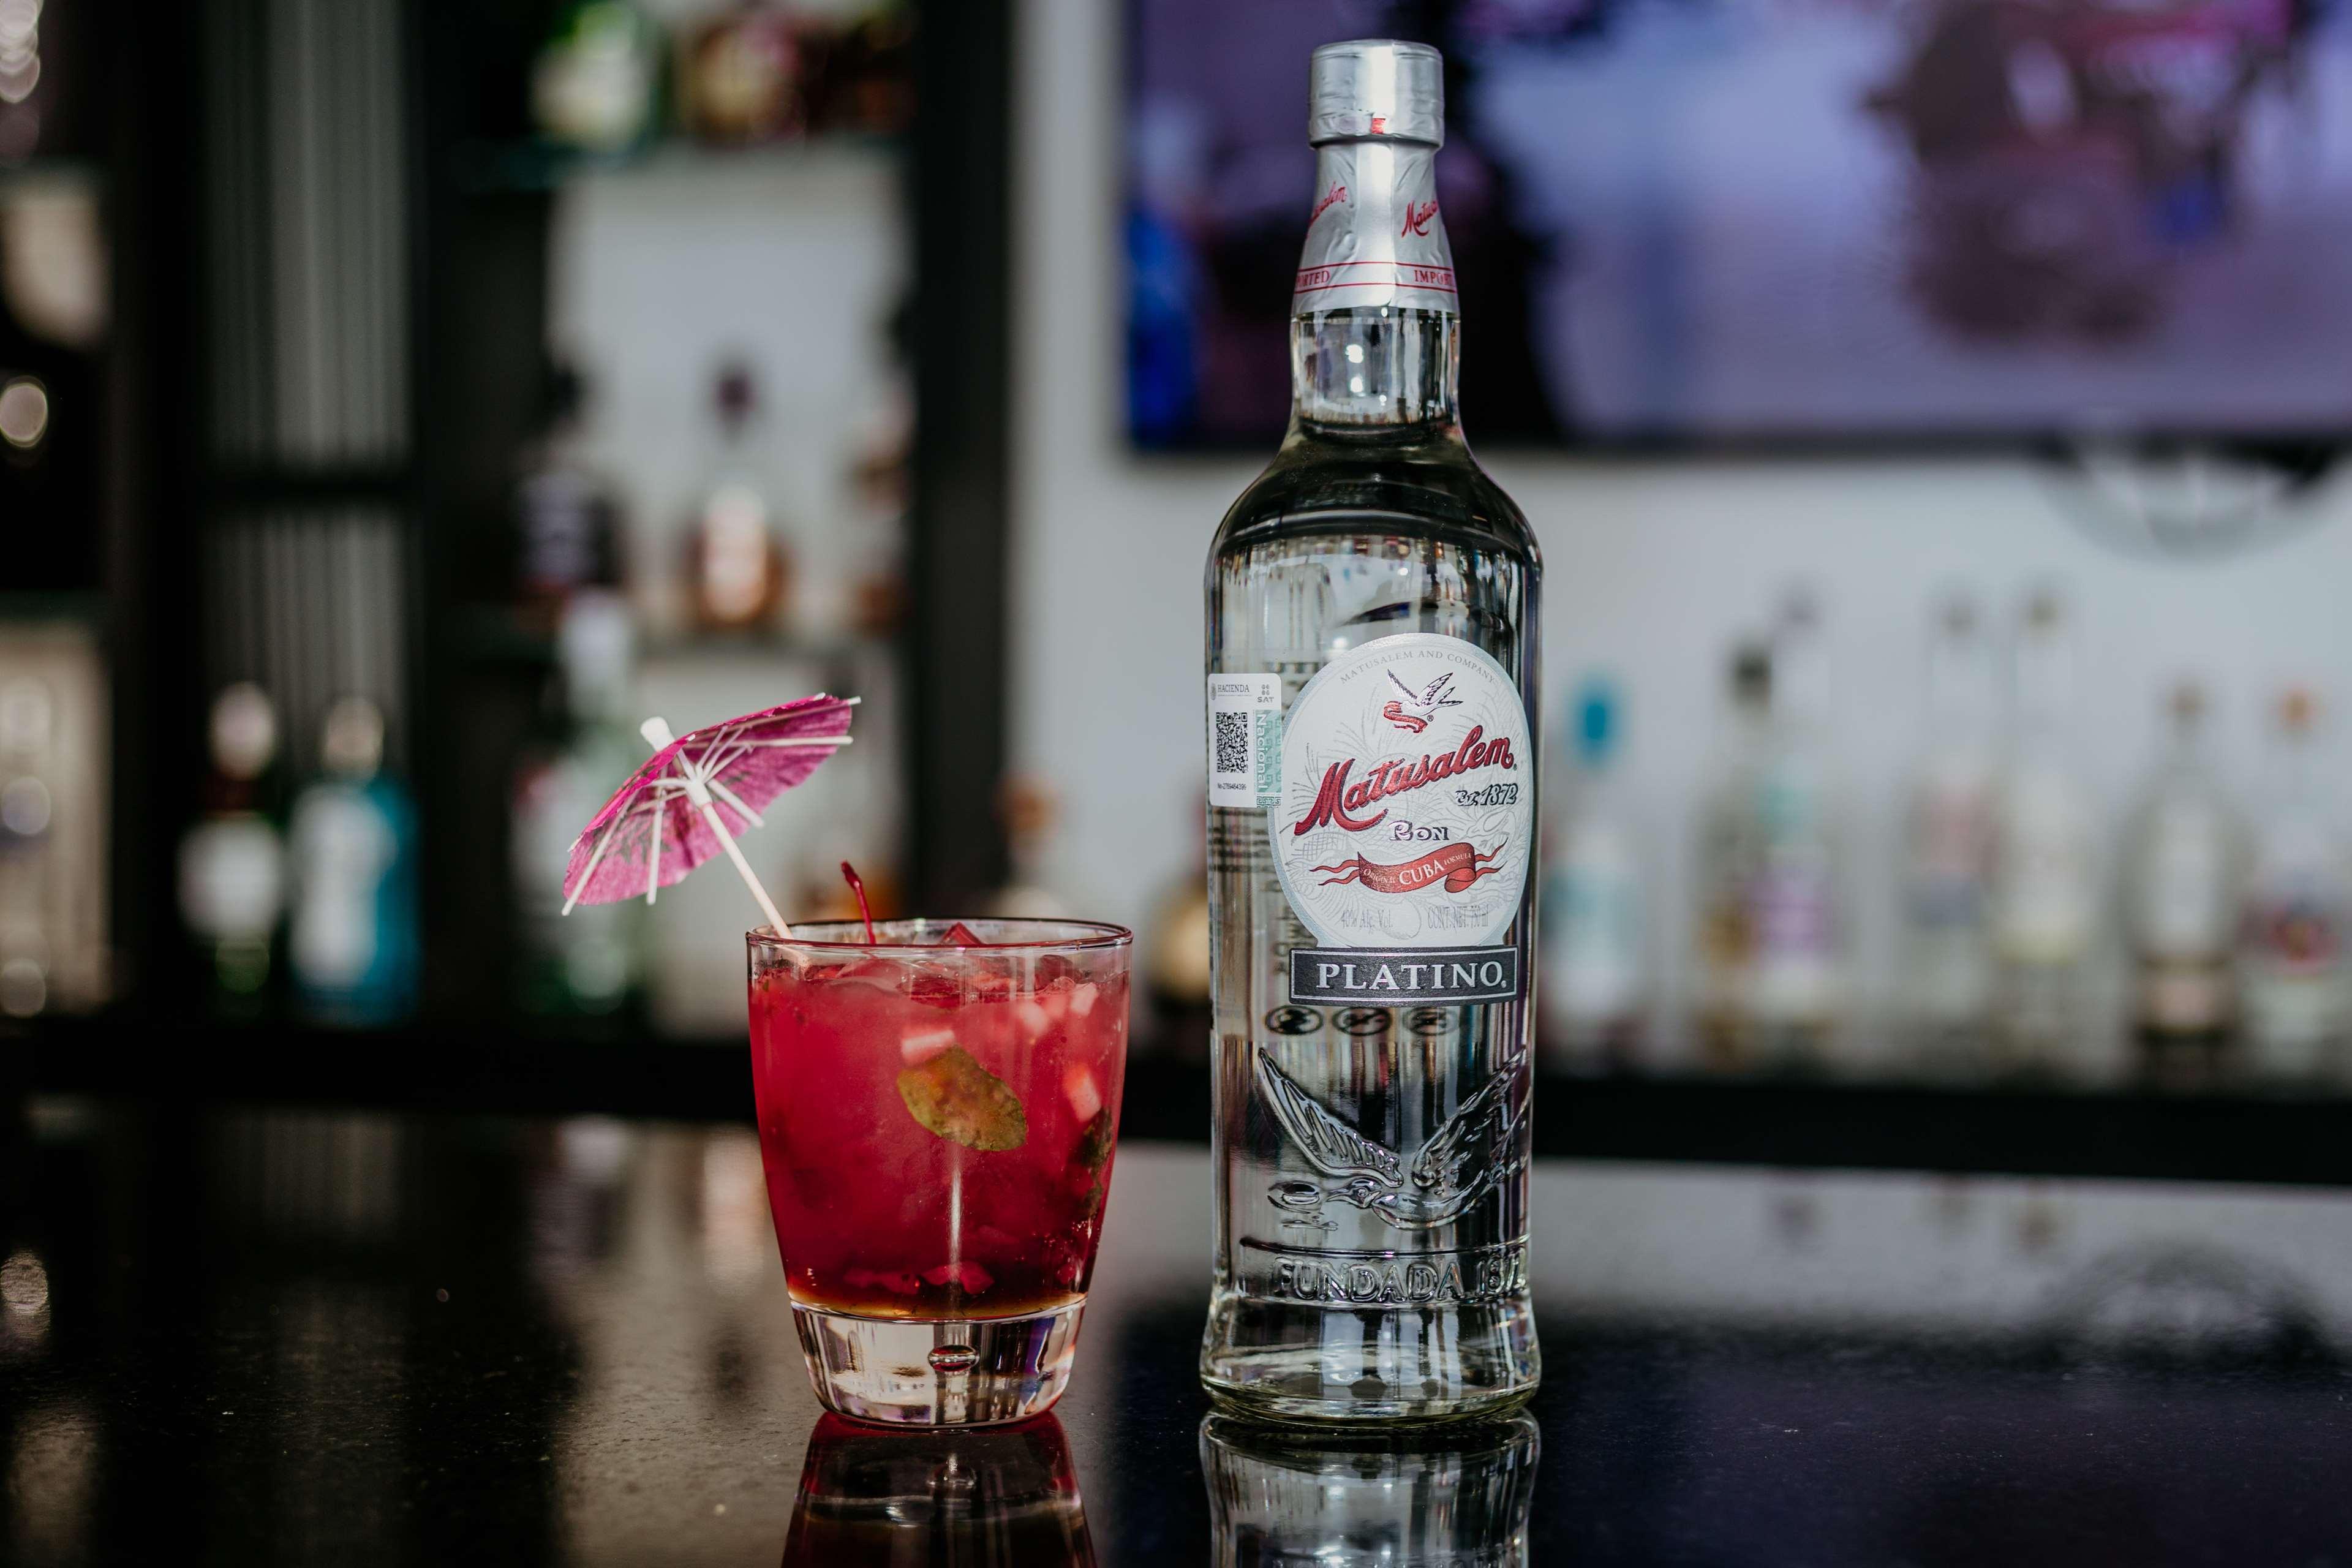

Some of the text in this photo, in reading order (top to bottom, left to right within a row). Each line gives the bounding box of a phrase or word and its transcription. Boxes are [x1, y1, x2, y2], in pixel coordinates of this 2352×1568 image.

[1340, 650, 1413, 684] MATUSALEM
[1447, 654, 1496, 684] COMPANY
[1218, 684, 1250, 693] HACIENDA
[1256, 714, 1268, 789] Nacional
[1294, 725, 1515, 836] Matusalem
[1480, 783, 1518, 806] 1872
[1399, 859, 1445, 885] CUBA
[1275, 1256, 1466, 1302] FUNDADA
